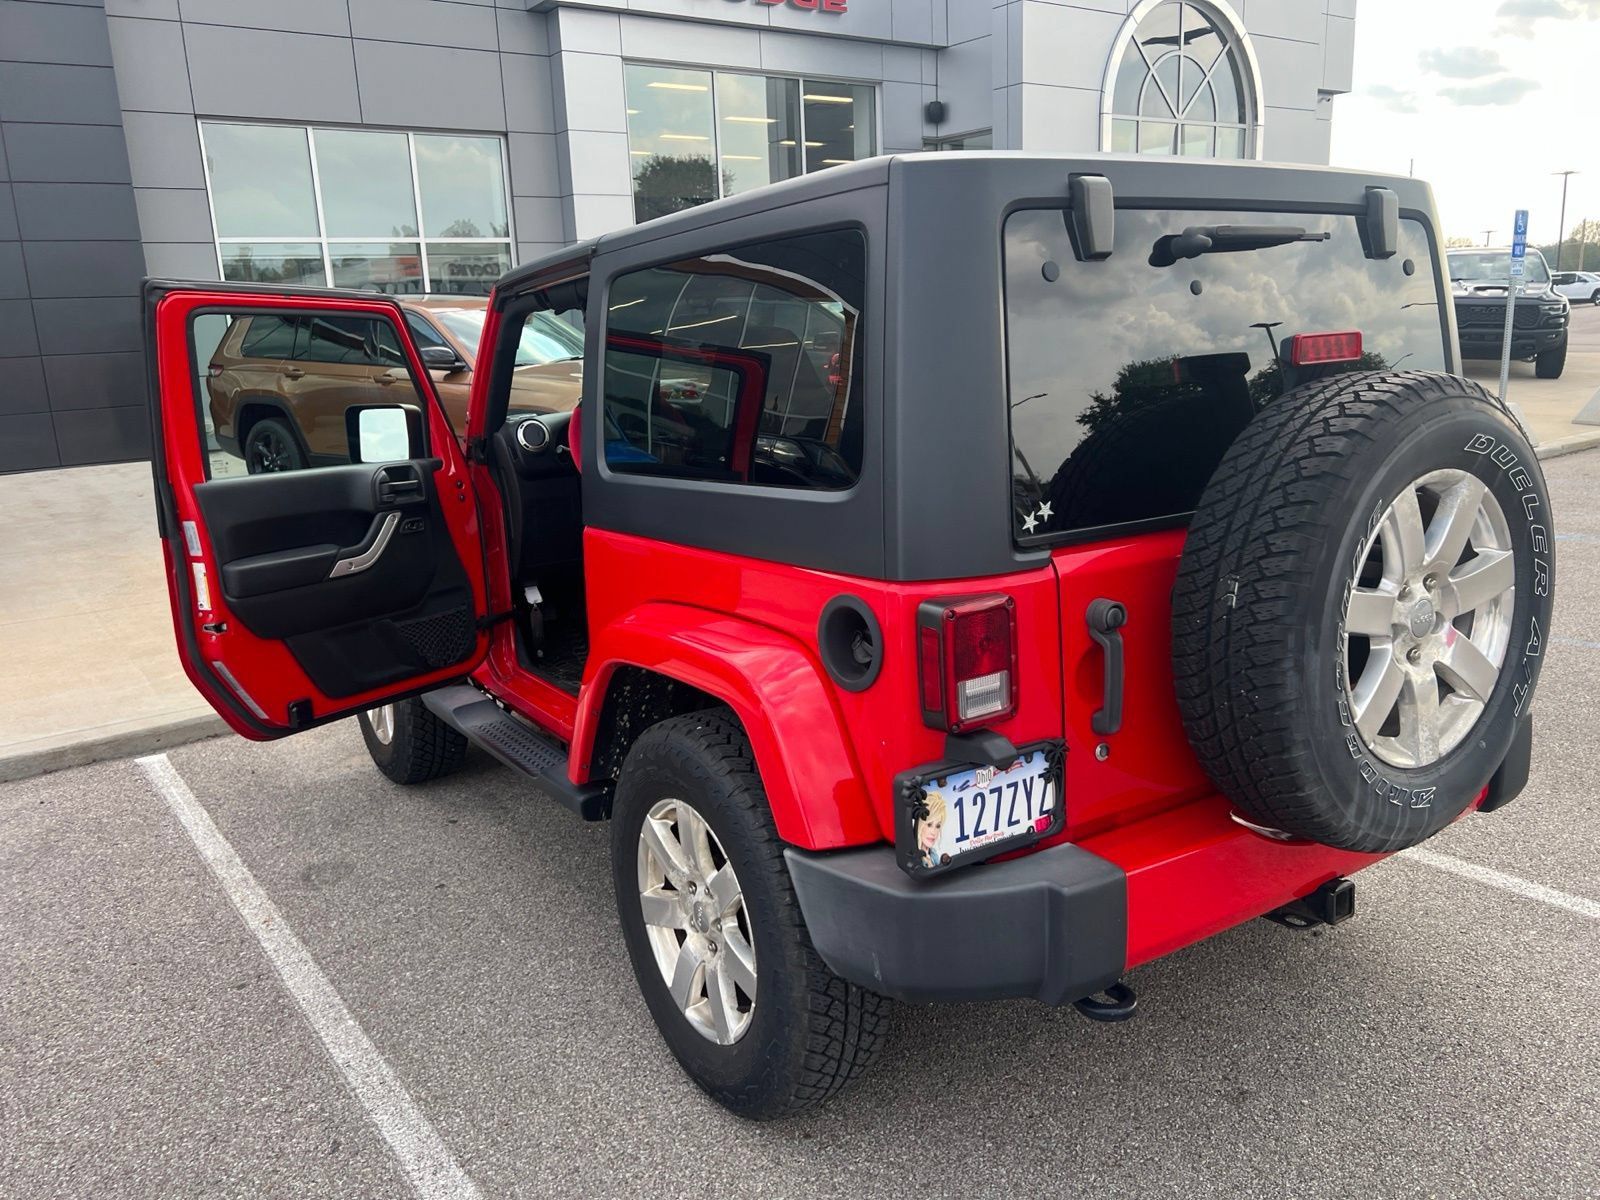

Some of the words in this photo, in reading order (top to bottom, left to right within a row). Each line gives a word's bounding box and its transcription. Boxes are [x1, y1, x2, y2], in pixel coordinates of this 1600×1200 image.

[1464, 433, 1549, 597] DUELER
[1511, 616, 1542, 717] A/T
[976, 770, 993, 784] Ohio
